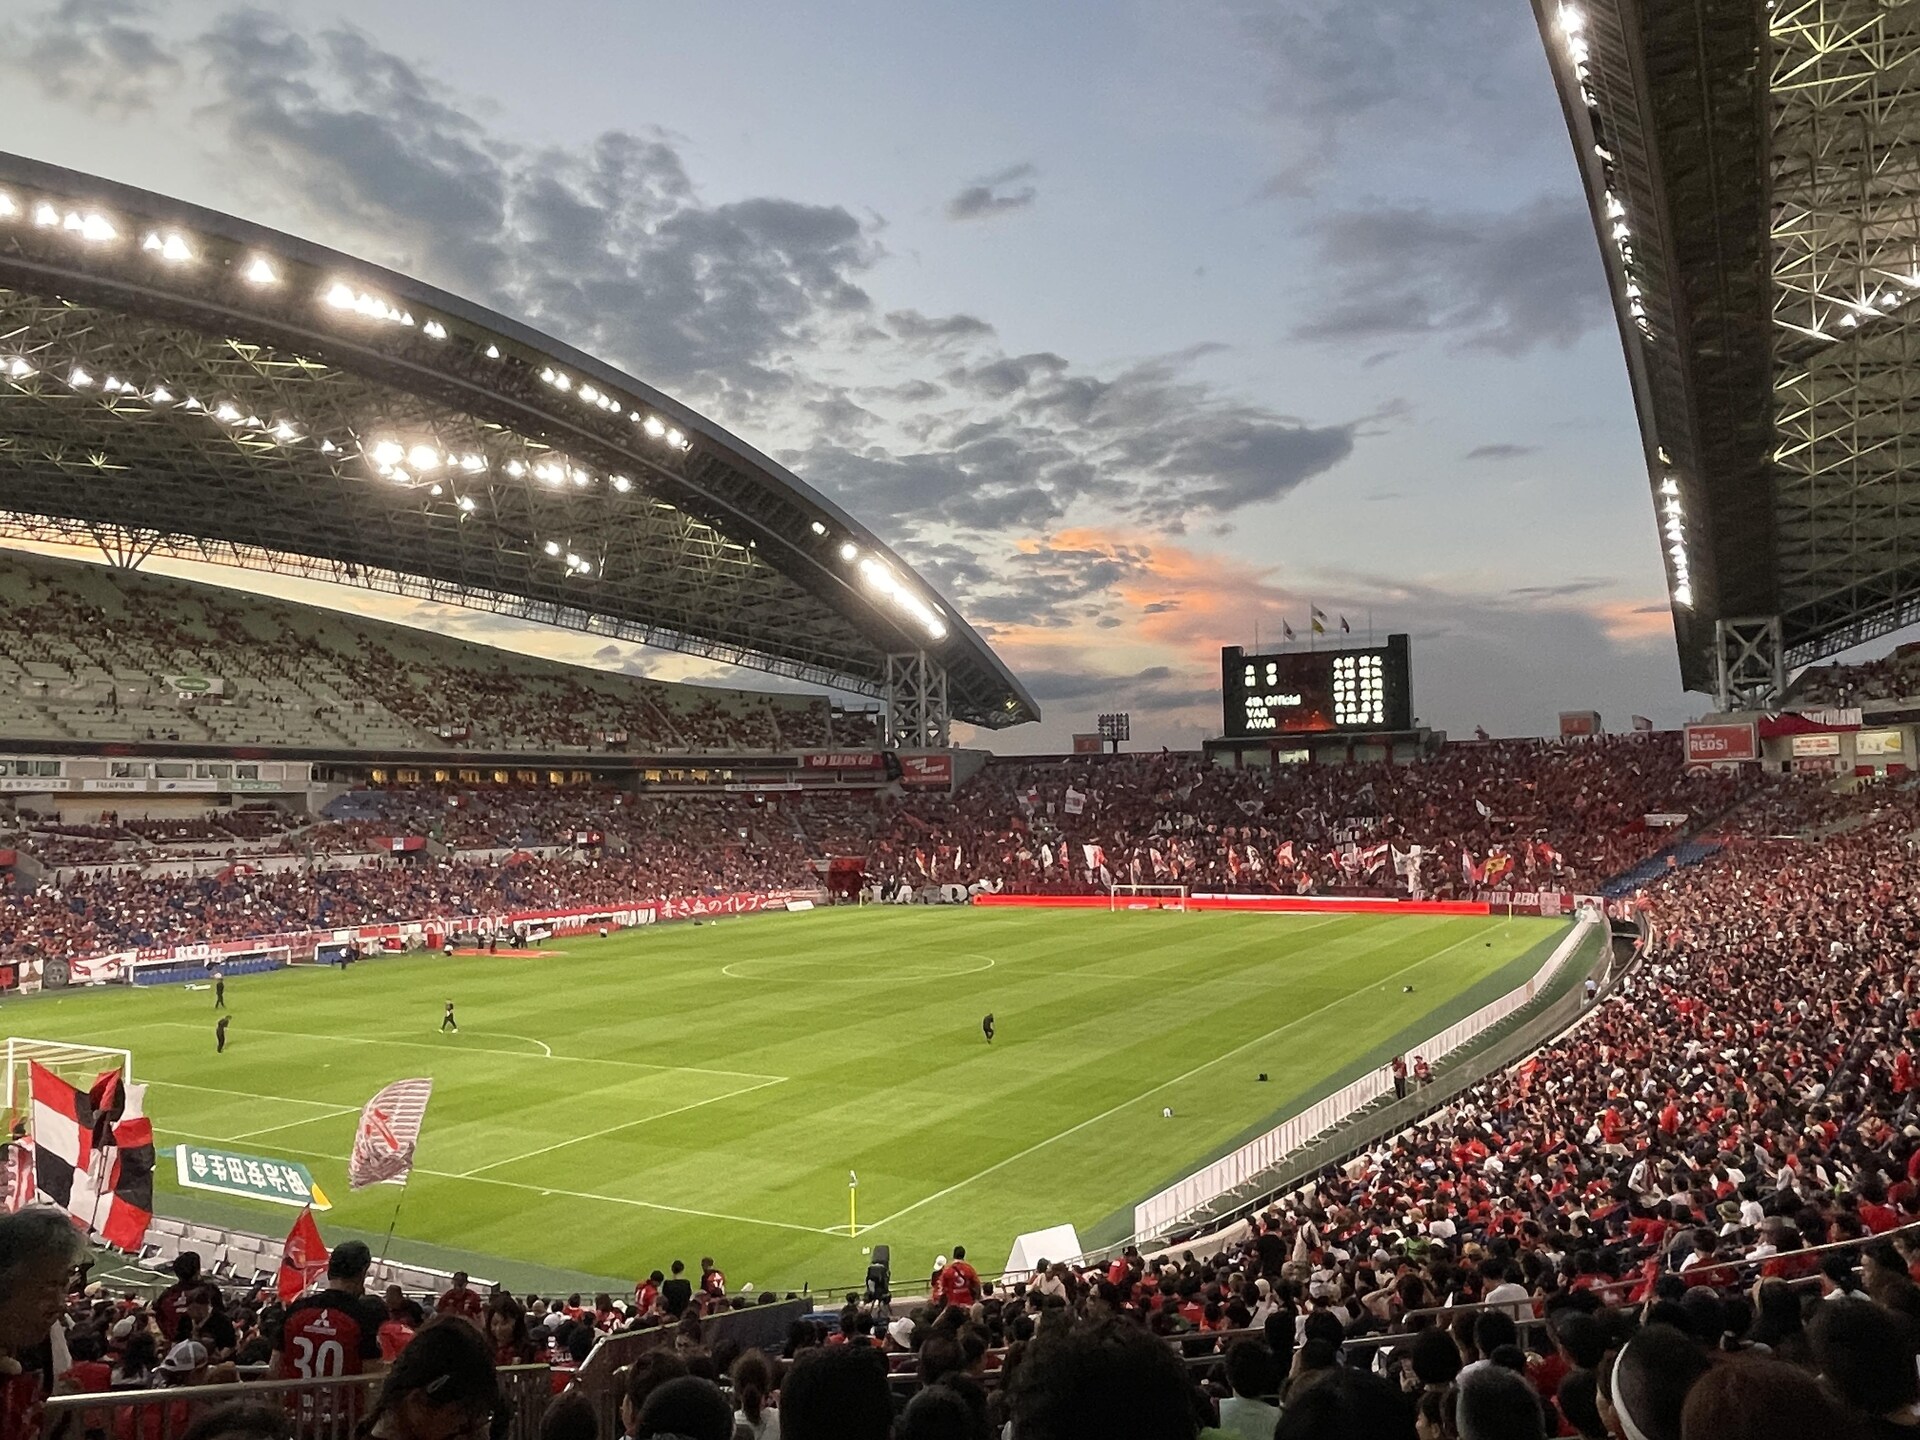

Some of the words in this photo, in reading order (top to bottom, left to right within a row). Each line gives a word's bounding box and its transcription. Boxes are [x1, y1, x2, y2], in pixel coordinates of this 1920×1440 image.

[1264, 693, 1301, 706] Official
[1245, 707, 1268, 718] VAR
[1245, 717, 1276, 729] AVAR
[812, 755, 827, 766] GO
[857, 755, 873, 766] GO
[190, 1151, 311, 1196] 明治安田生命
[292, 1336, 344, 1379] 30
